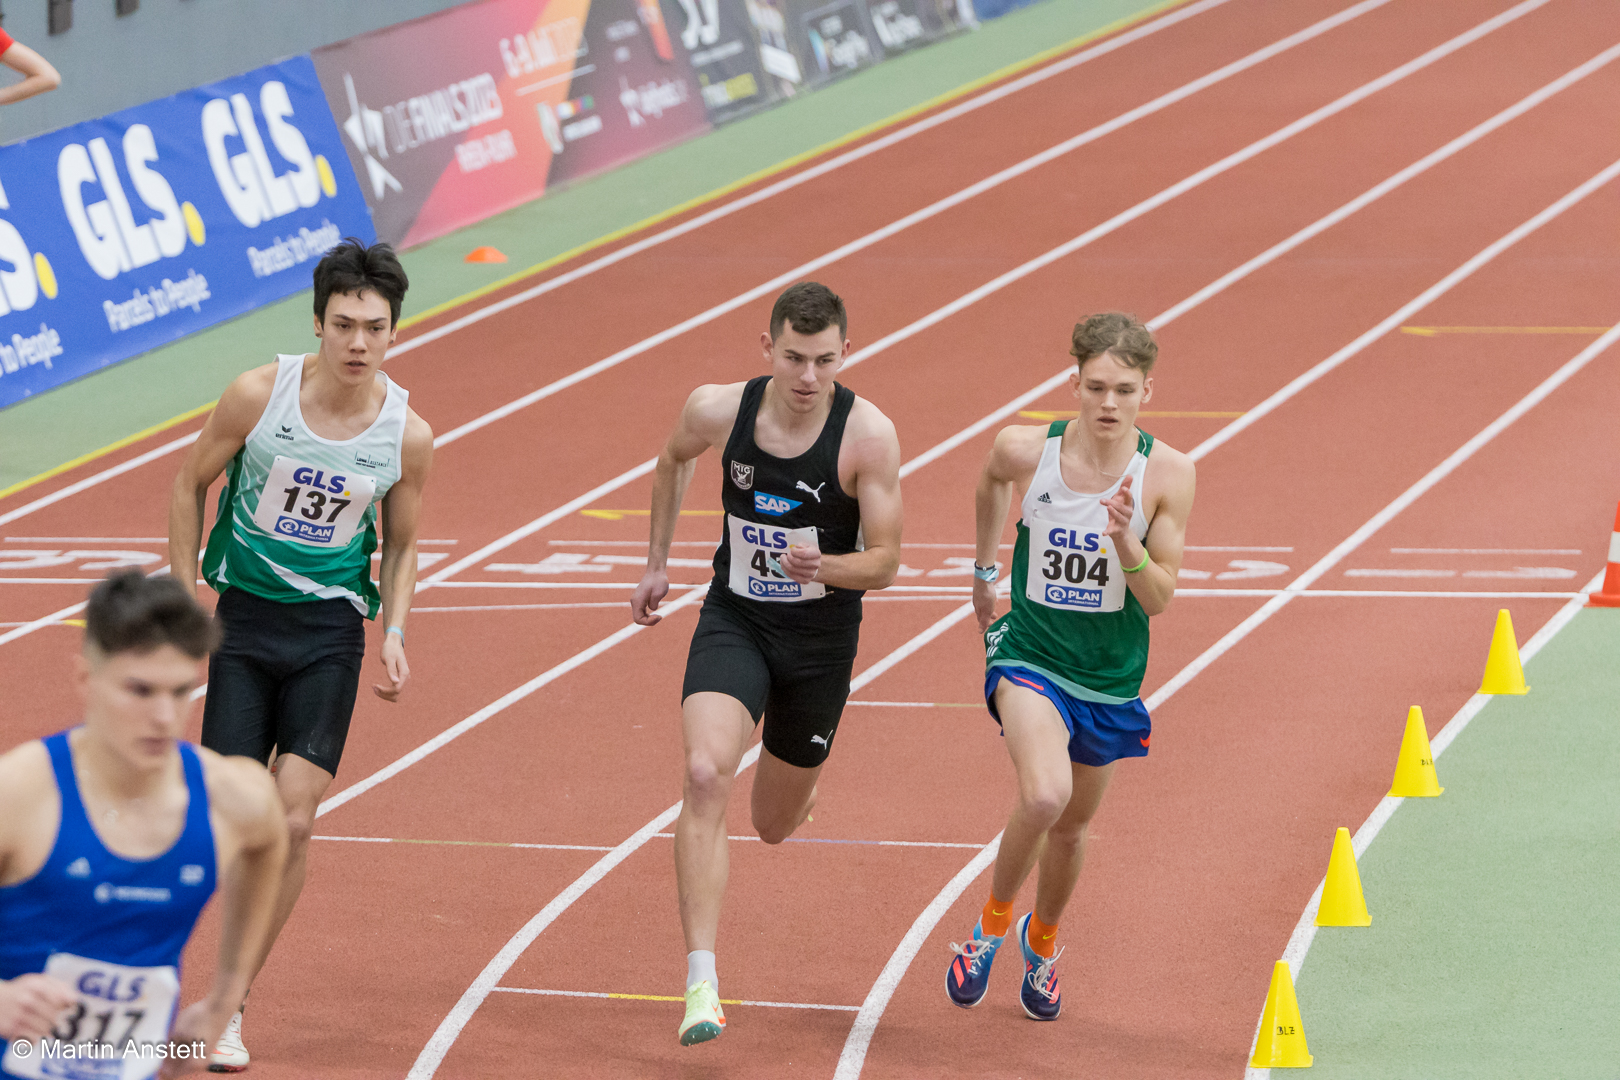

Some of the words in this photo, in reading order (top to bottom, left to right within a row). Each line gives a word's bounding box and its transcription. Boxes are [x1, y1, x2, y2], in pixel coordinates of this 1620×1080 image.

[283, 486, 352, 523] 137
[755, 495, 791, 513] SAP
[300, 524, 332, 537] PLAN
[1042, 549, 1110, 587] 304
[767, 584, 799, 592] PLAN
[1068, 590, 1100, 602] PLAN
[53, 1001, 146, 1050] 317
